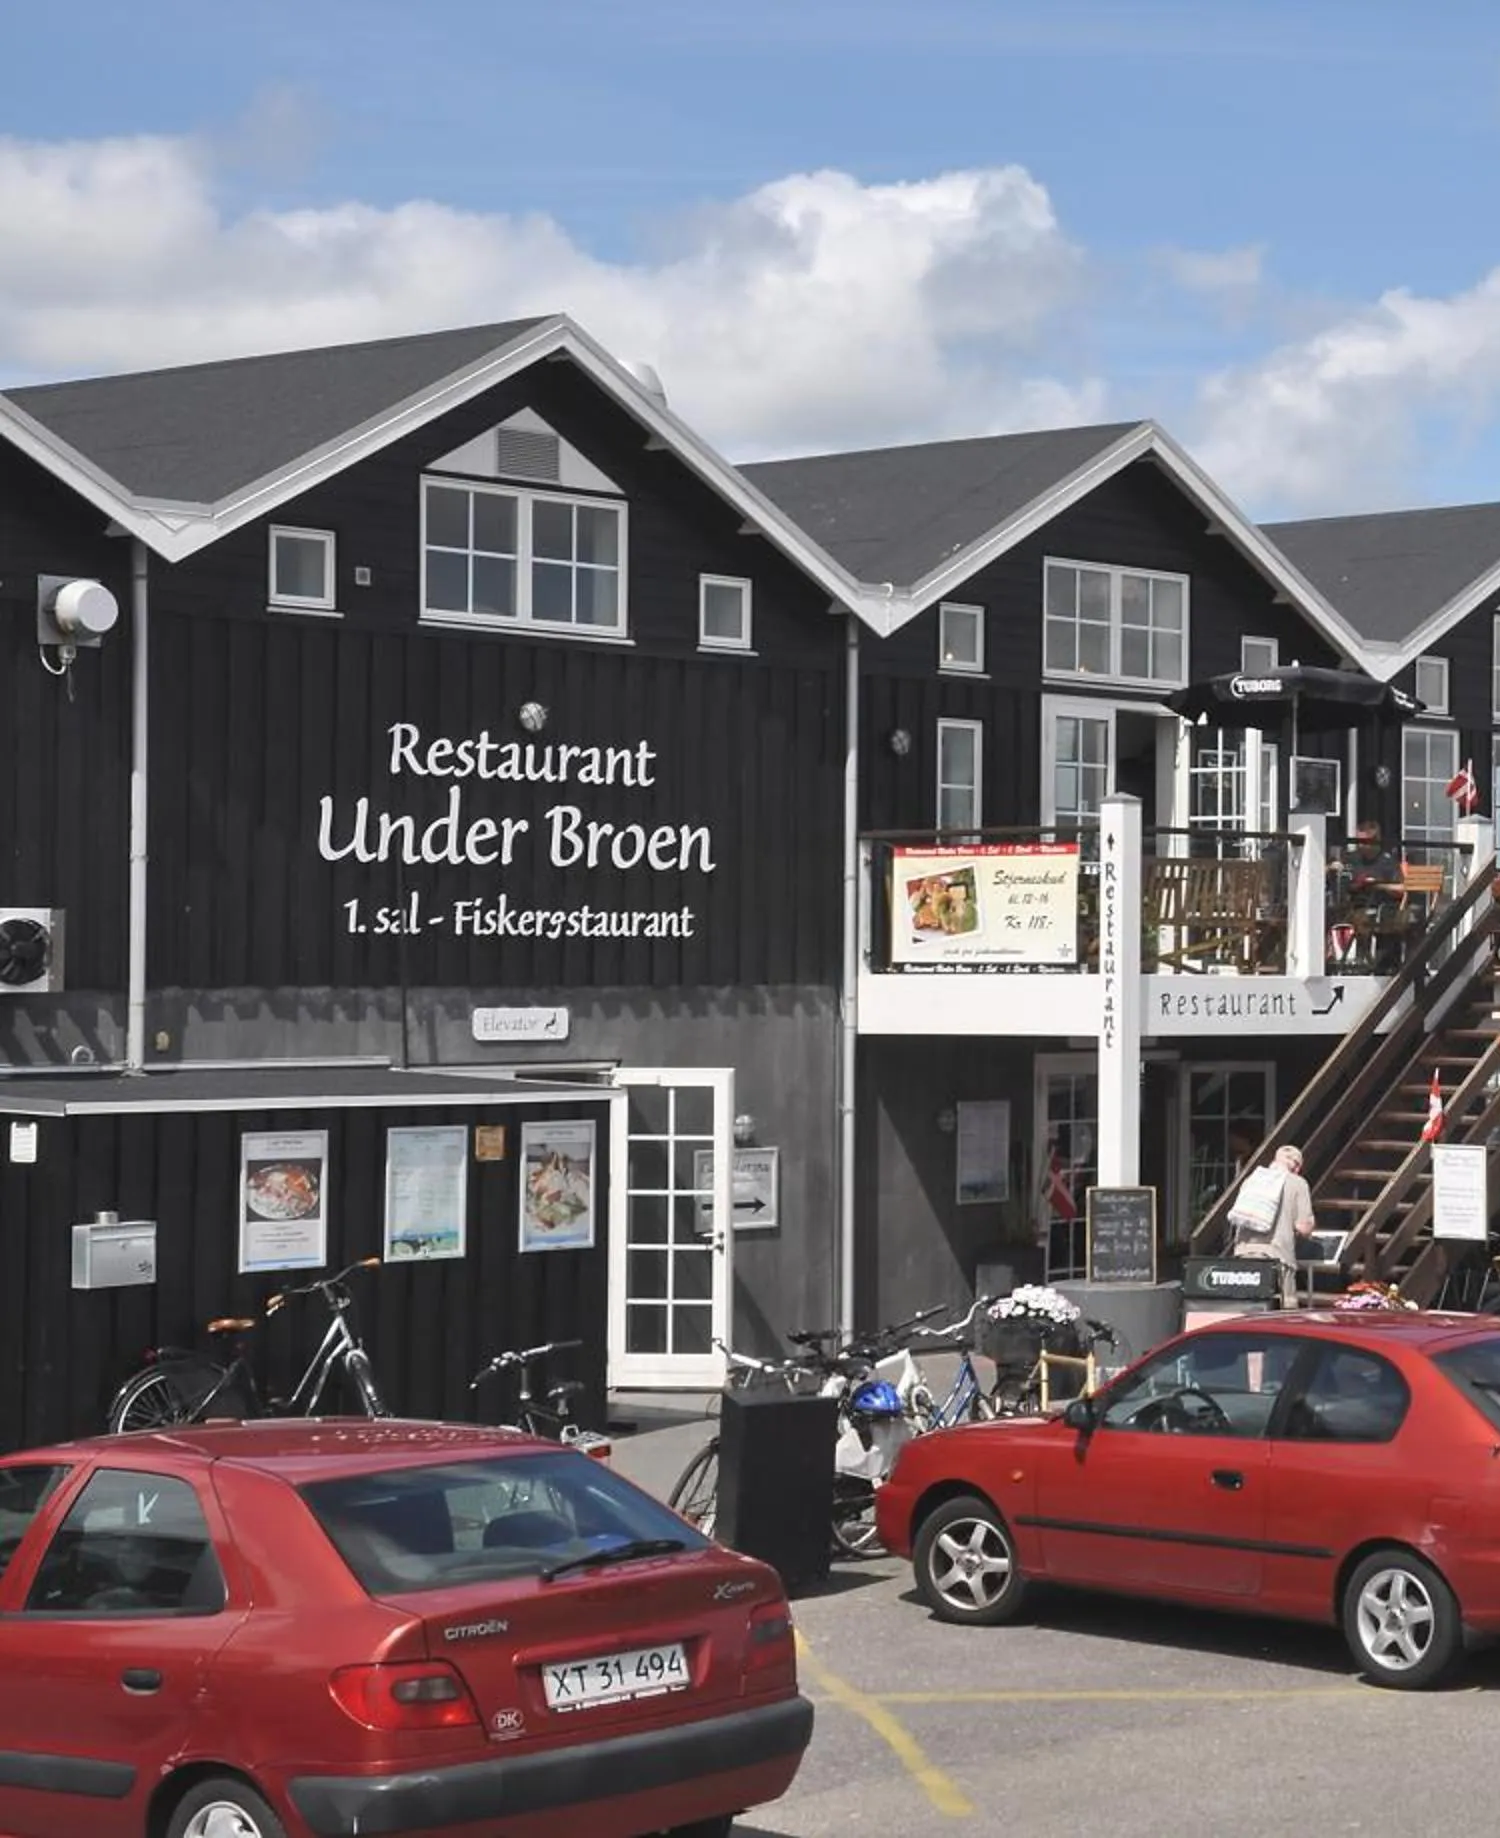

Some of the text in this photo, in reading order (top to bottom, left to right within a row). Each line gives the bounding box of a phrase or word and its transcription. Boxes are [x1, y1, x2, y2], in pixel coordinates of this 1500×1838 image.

[1237, 679, 1282, 692] TUBORG
[388, 722, 656, 787] Restaurant
[318, 785, 716, 872] Under Broen
[344, 898, 366, 934] 1.
[374, 890, 421, 934] sal
[453, 893, 695, 939] Fiskerestaurant
[1103, 863, 1117, 1050] Restaurant
[1160, 992, 1297, 1016] Restaurant
[1211, 1271, 1260, 1285] TUBORG
[444, 1619, 508, 1640] CITROËN
[551, 1649, 682, 1699] XT 31 494
[497, 1712, 518, 1729] DK
